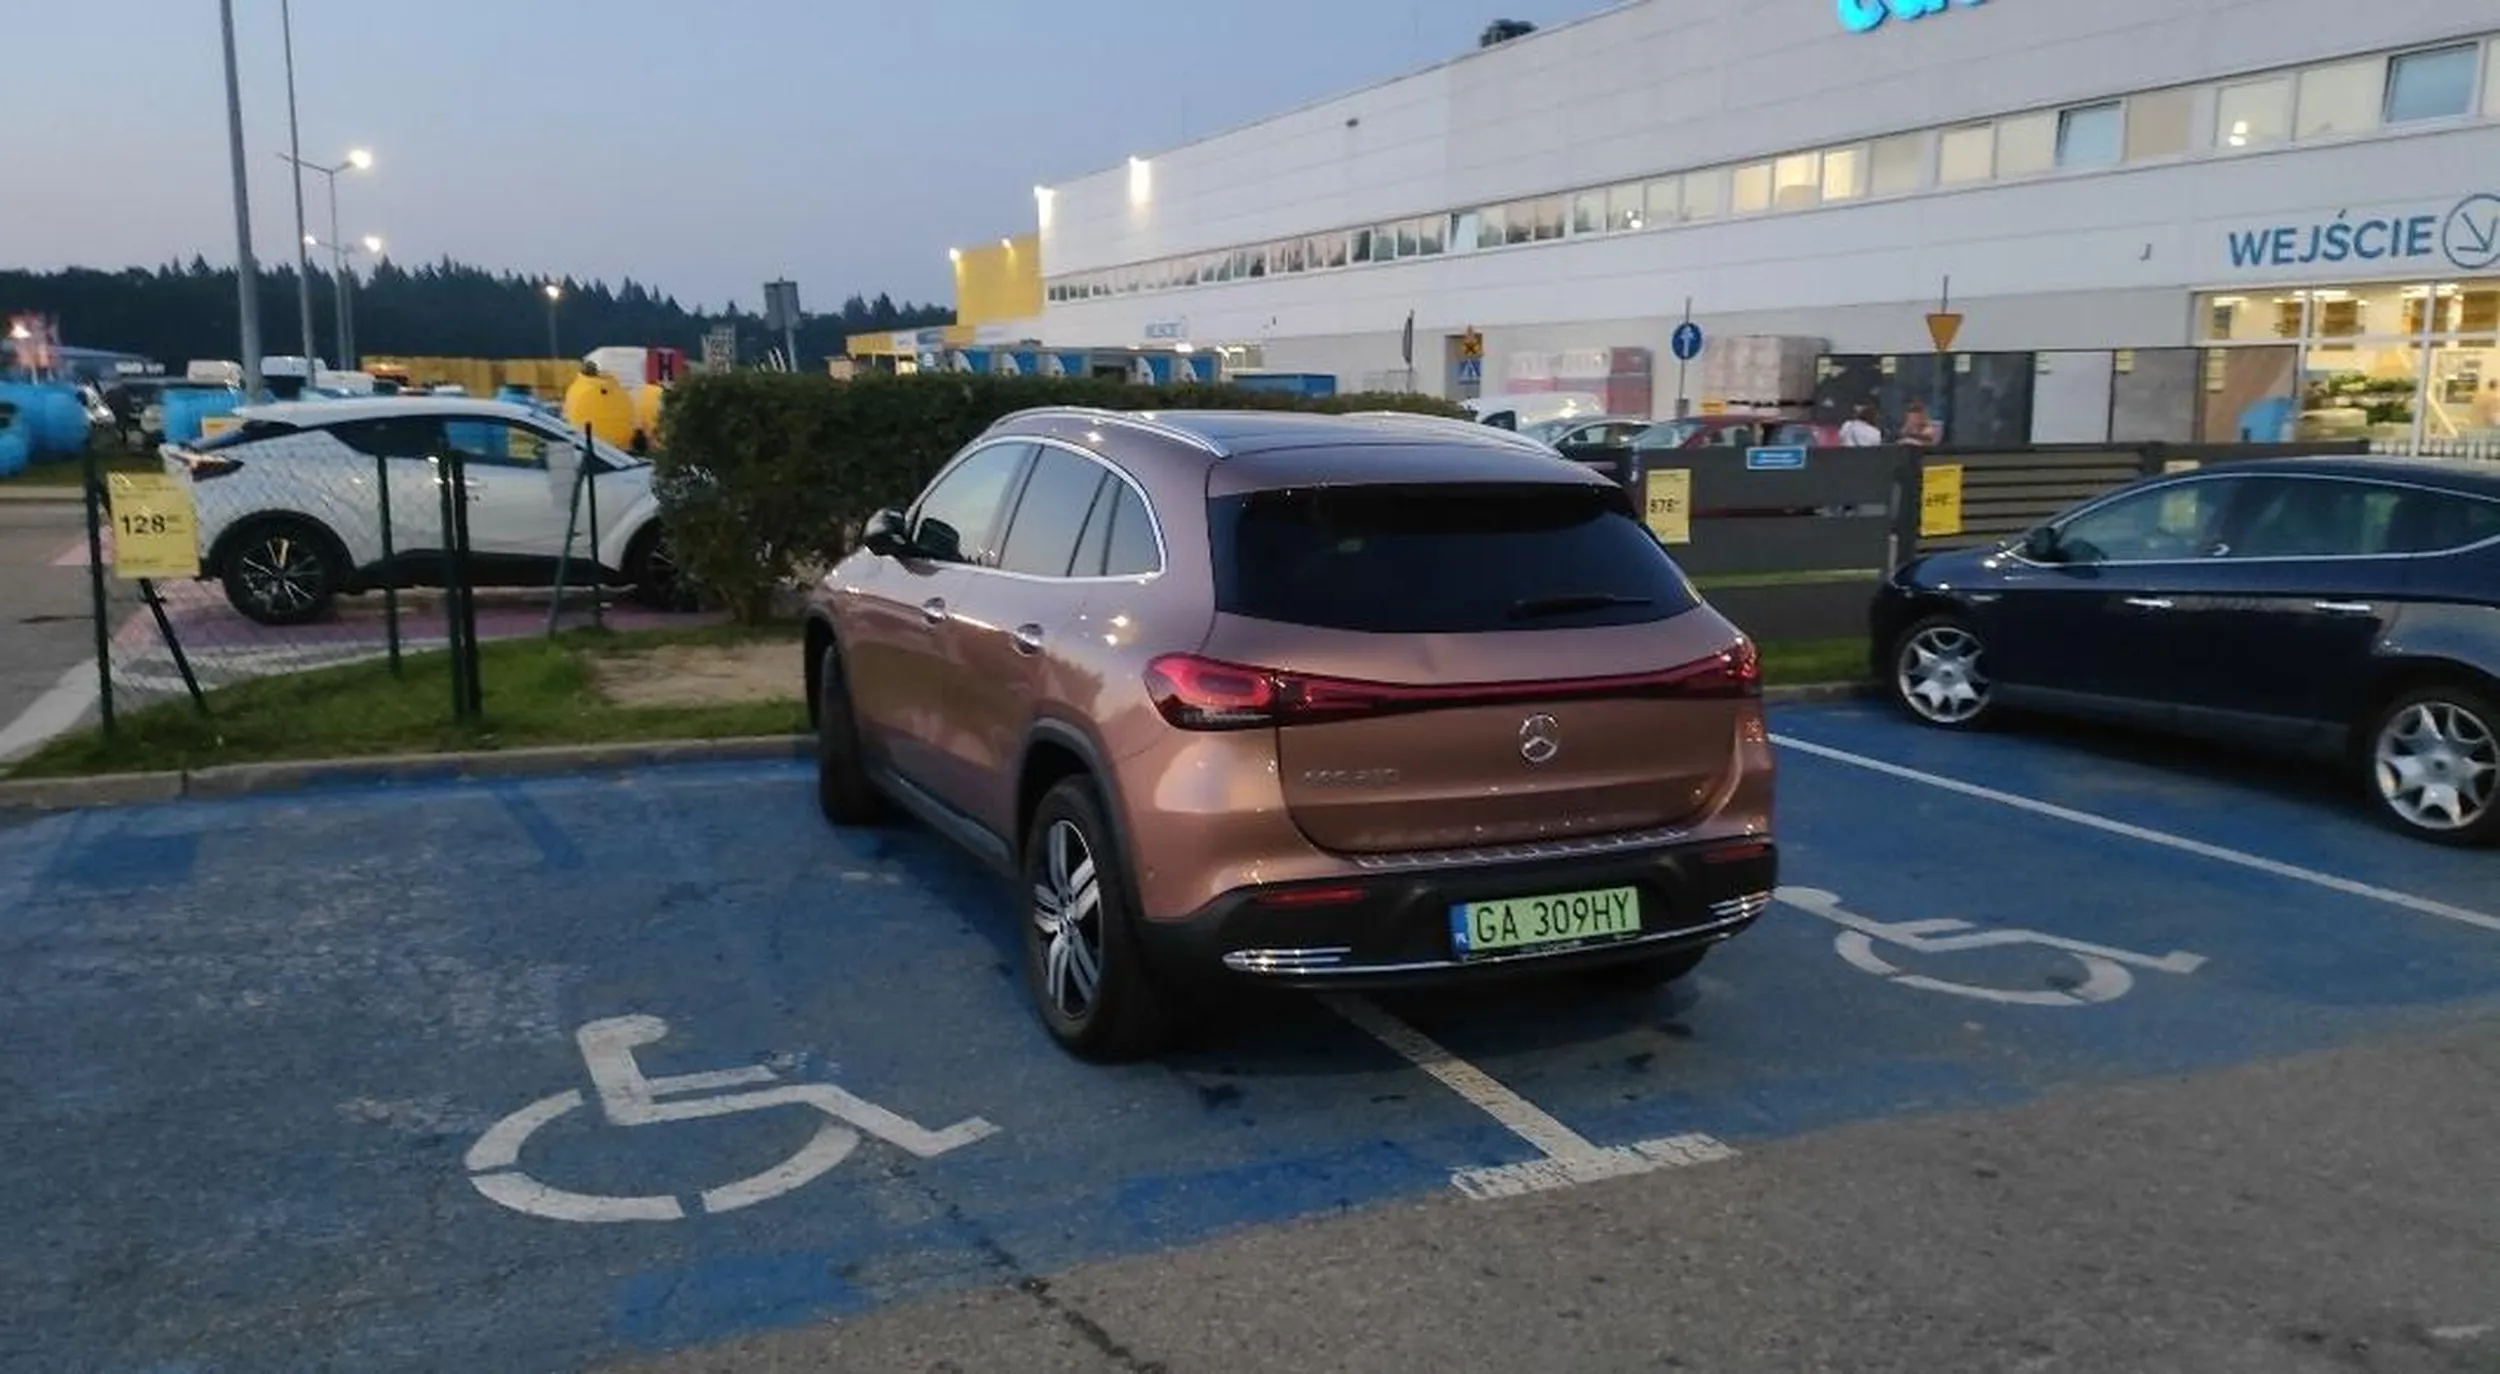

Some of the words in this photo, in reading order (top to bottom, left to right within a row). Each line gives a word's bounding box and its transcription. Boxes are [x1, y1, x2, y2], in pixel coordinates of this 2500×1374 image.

[2228, 208, 2437, 268] WEJŚCIE
[121, 514, 165, 535] 128
[1476, 903, 1519, 943] GA
[1532, 890, 1629, 936] 309HY
